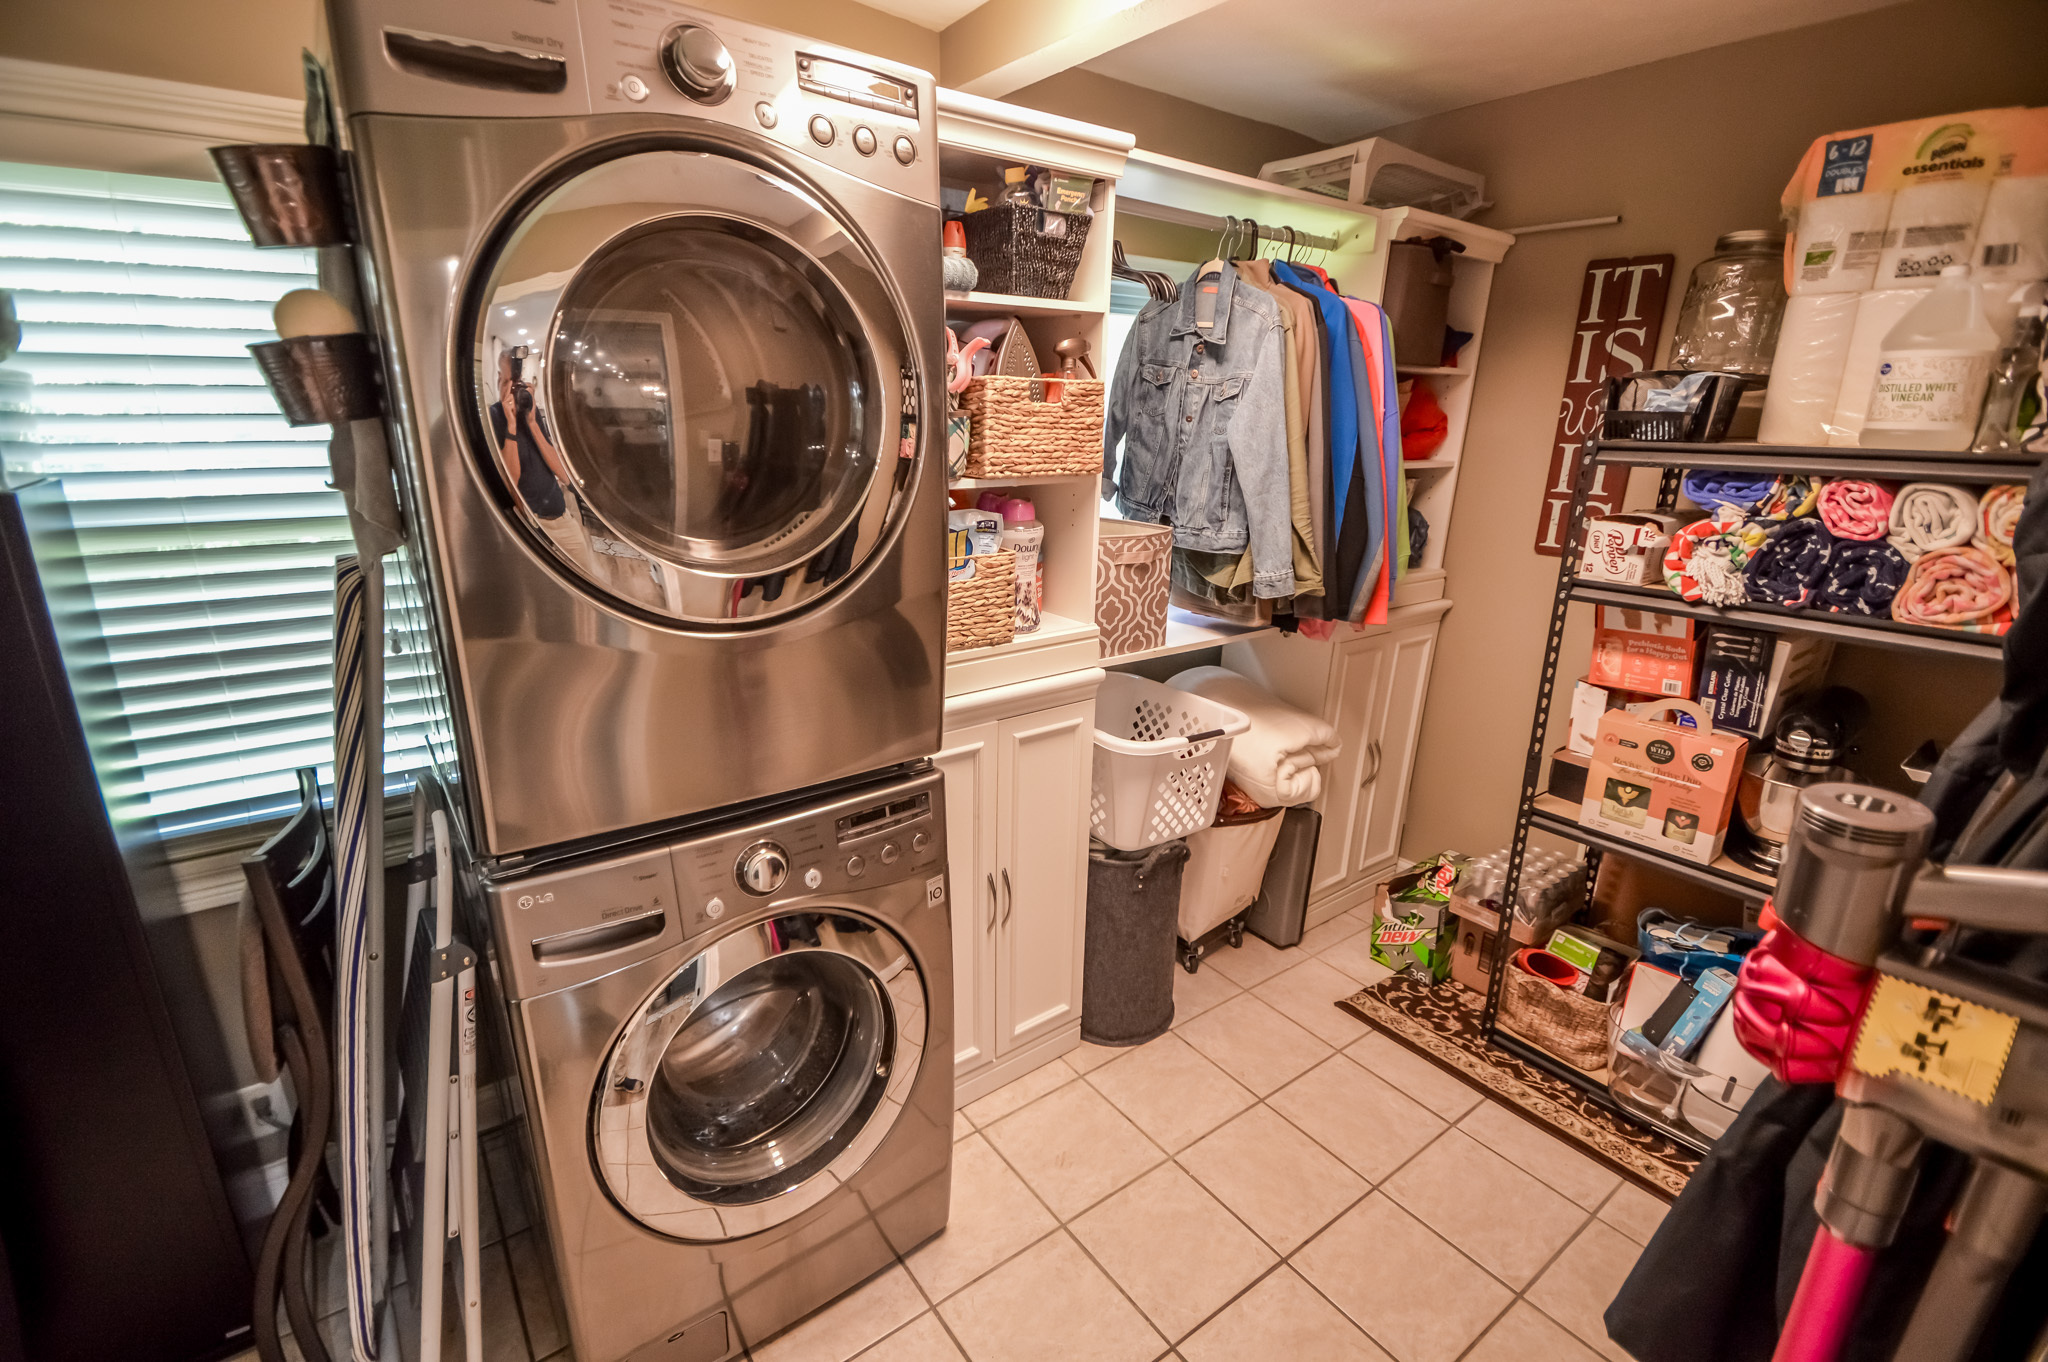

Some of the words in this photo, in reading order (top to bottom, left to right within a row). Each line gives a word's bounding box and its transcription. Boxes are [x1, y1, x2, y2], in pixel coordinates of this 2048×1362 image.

[511, 30, 544, 45] Sensor
[546, 37, 564, 50] Dry
[1828, 144, 1839, 161] 6
[1849, 139, 1869, 157] 12
[1902, 155, 1986, 177] essentials
[1056, 186, 1086, 199] Emergency
[1580, 263, 1663, 324] IT
[1568, 327, 1646, 383] IS
[1878, 382, 1923, 393] DISTILLED
[1925, 382, 1959, 392] WHITE
[1890, 392, 1935, 402] VINEGAR
[1593, 534, 1601, 549] Diet
[1605, 532, 1625, 572] Pepper
[1585, 562, 1594, 573] 12
[1628, 639, 1665, 650] Prebiotic
[1665, 645, 1687, 654] Soda
[1645, 647, 1671, 660] Happy
[1671, 652, 1688, 660] Gut
[1707, 670, 1717, 695] KIRKLAND
[1723, 668, 1733, 688] Cutlery
[1721, 688, 1729, 702] Clear
[1717, 701, 1727, 720] Crystal
[1650, 746, 1672, 757] WILD
[1680, 774, 1702, 786] Duo
[535, 892, 554, 903] LG
[929, 887, 943, 901] 10
[601, 907, 624, 920] Direct
[624, 904, 644, 915] Drive
[1410, 968, 1426, 982] 36
